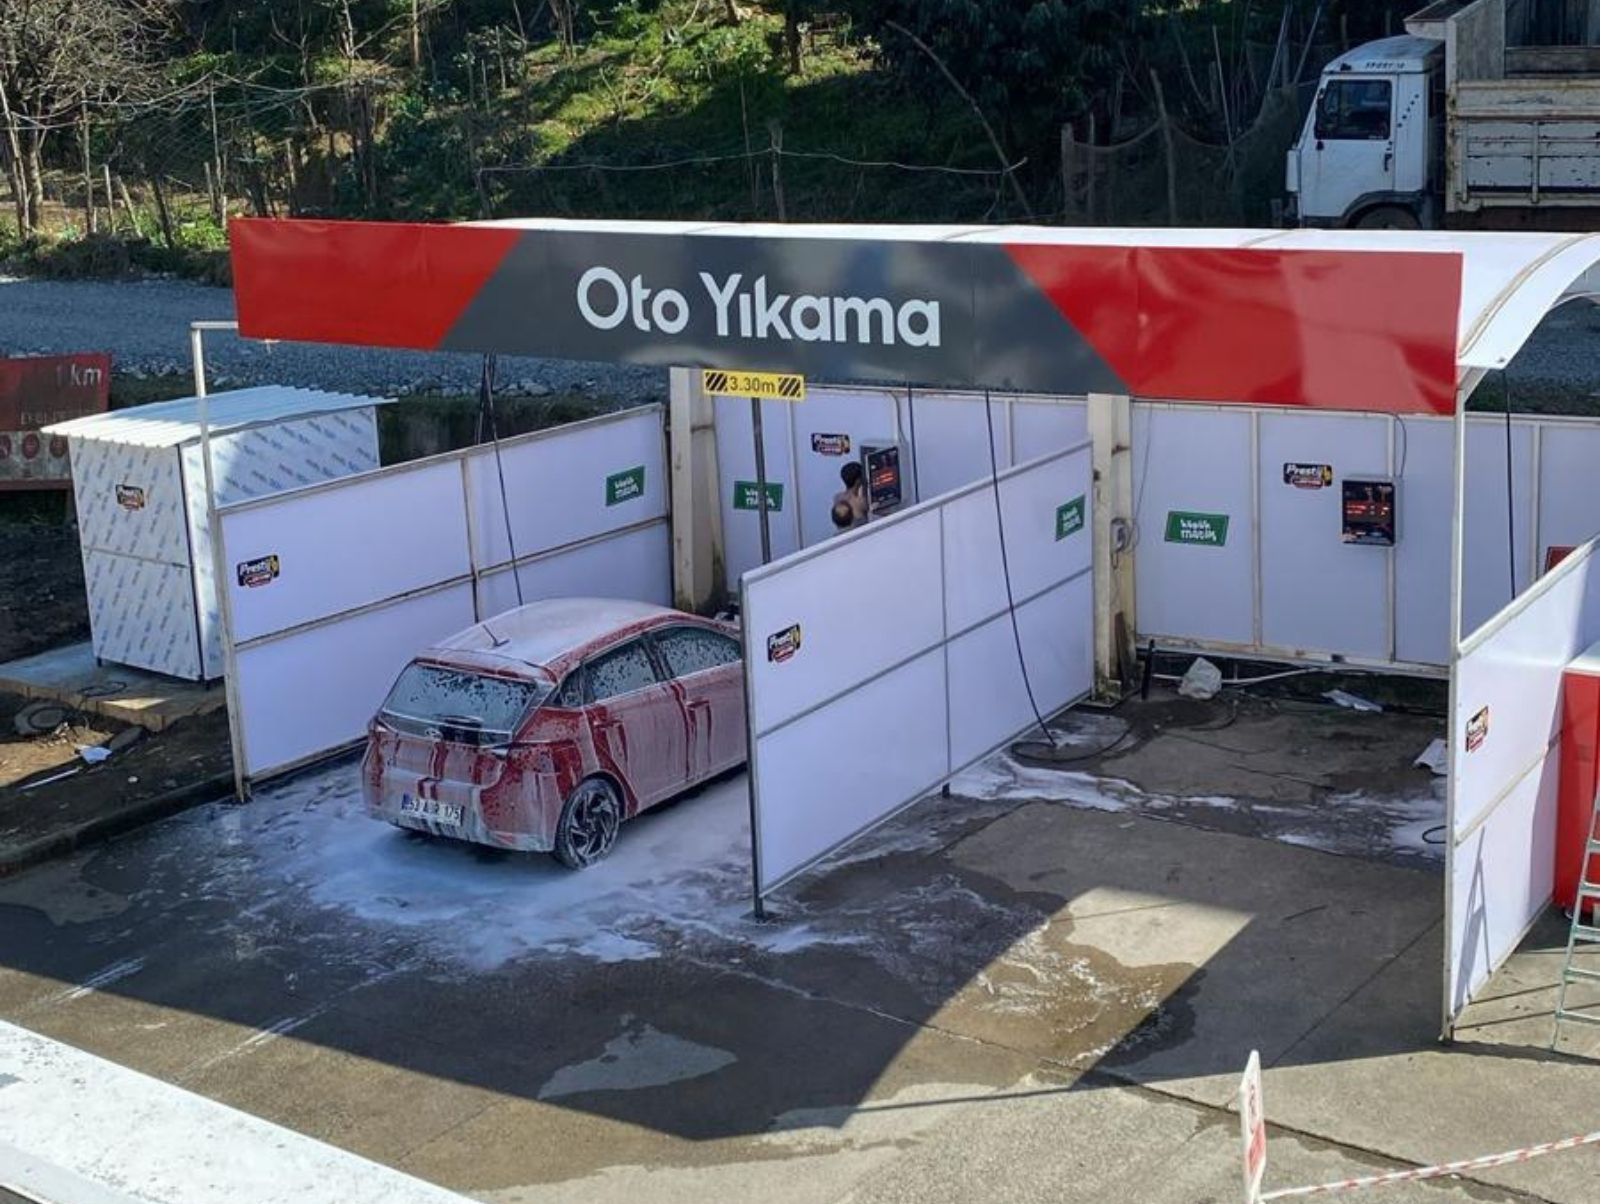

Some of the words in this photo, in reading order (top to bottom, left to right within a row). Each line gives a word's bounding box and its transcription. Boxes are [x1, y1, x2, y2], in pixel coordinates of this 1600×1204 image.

[577, 266, 690, 335] Oto
[699, 271, 942, 348] Yıkama
[71, 363, 102, 386] km
[728, 377, 776, 393] 3.30m
